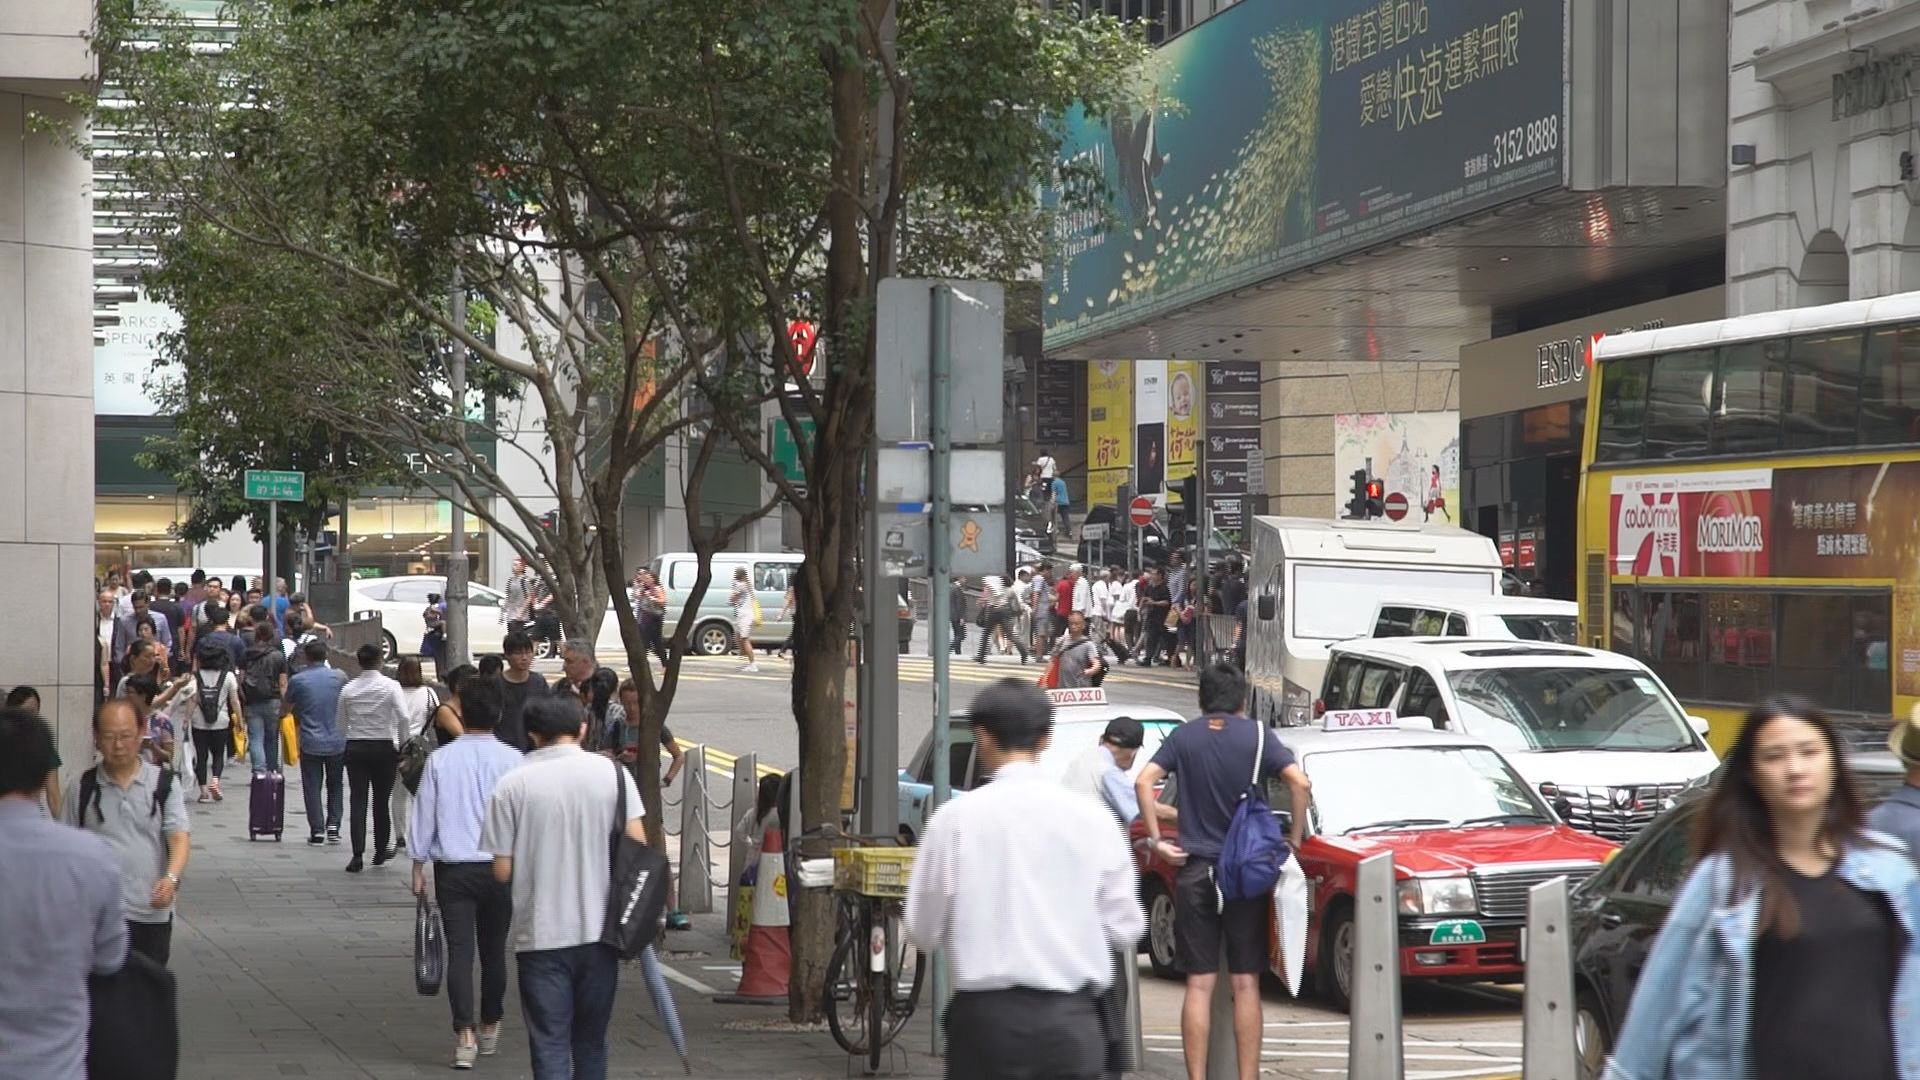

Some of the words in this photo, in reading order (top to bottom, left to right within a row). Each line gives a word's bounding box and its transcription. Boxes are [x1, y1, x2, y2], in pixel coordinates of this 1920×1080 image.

[1493, 126, 1523, 169] 3152
[1526, 114, 1558, 158] 8888
[114, 316, 157, 328] ARKS
[1536, 337, 1585, 389] HSBC
[1052, 690, 1102, 703] TAXI
[1335, 711, 1392, 727] TAXI
[1451, 924, 1463, 935] 4
[1441, 934, 1475, 943] SEATS
